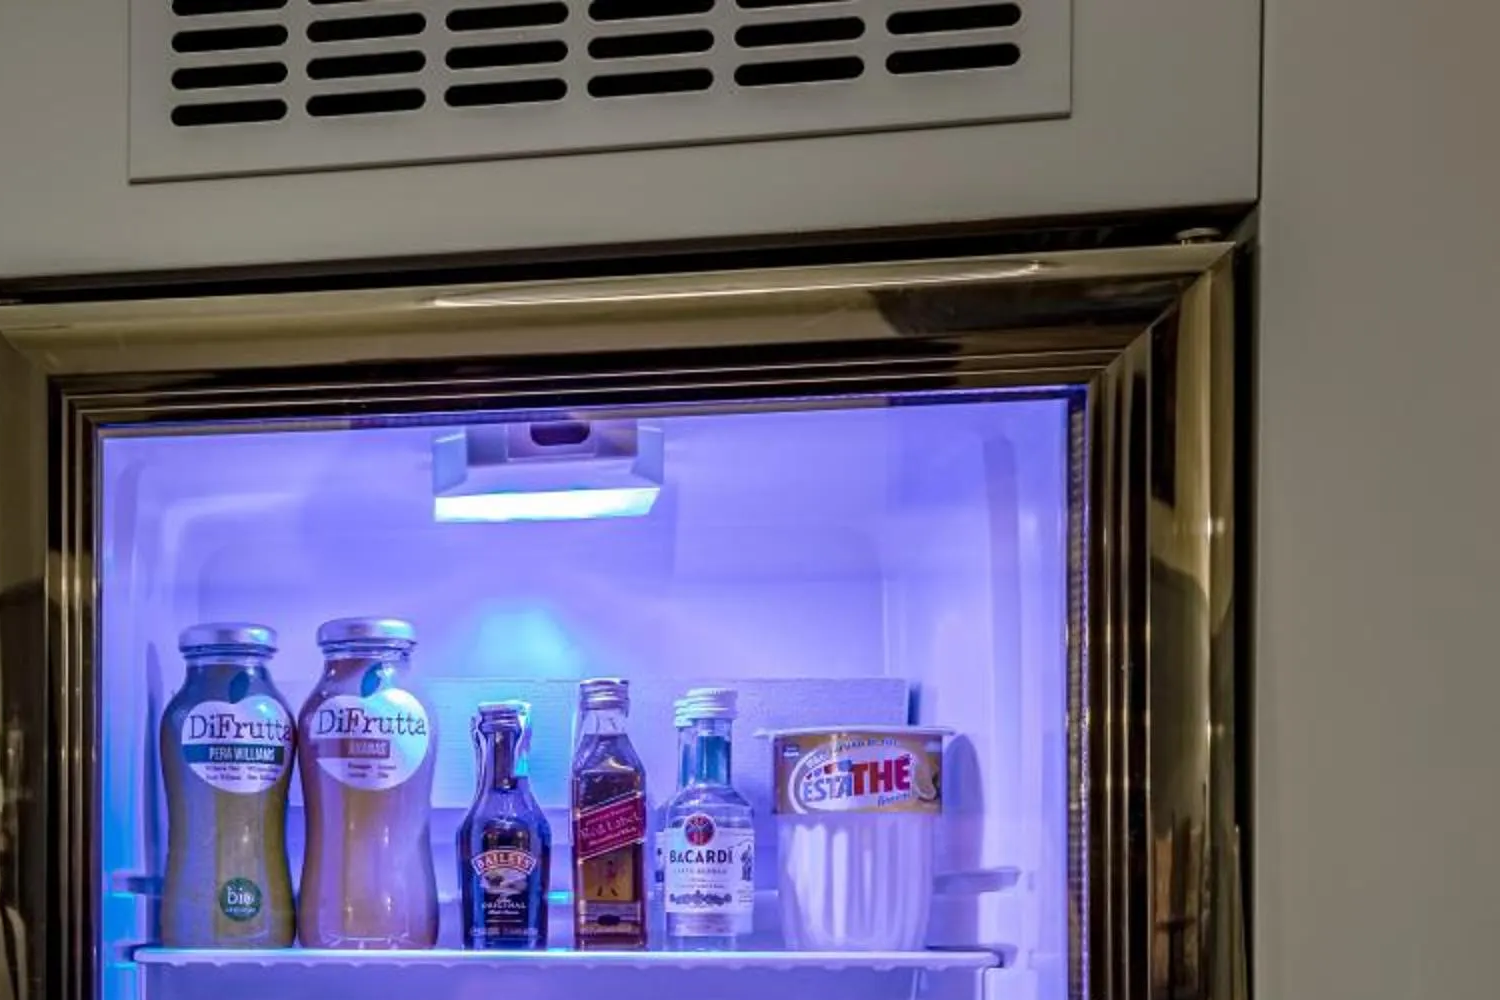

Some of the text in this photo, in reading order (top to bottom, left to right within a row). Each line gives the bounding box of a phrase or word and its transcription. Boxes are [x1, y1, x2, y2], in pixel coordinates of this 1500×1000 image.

[188, 713, 291, 742] DiFrutta
[316, 707, 427, 737] DiFrutta
[475, 852, 532, 870] BAILEYS
[227, 885, 256, 905] bio
